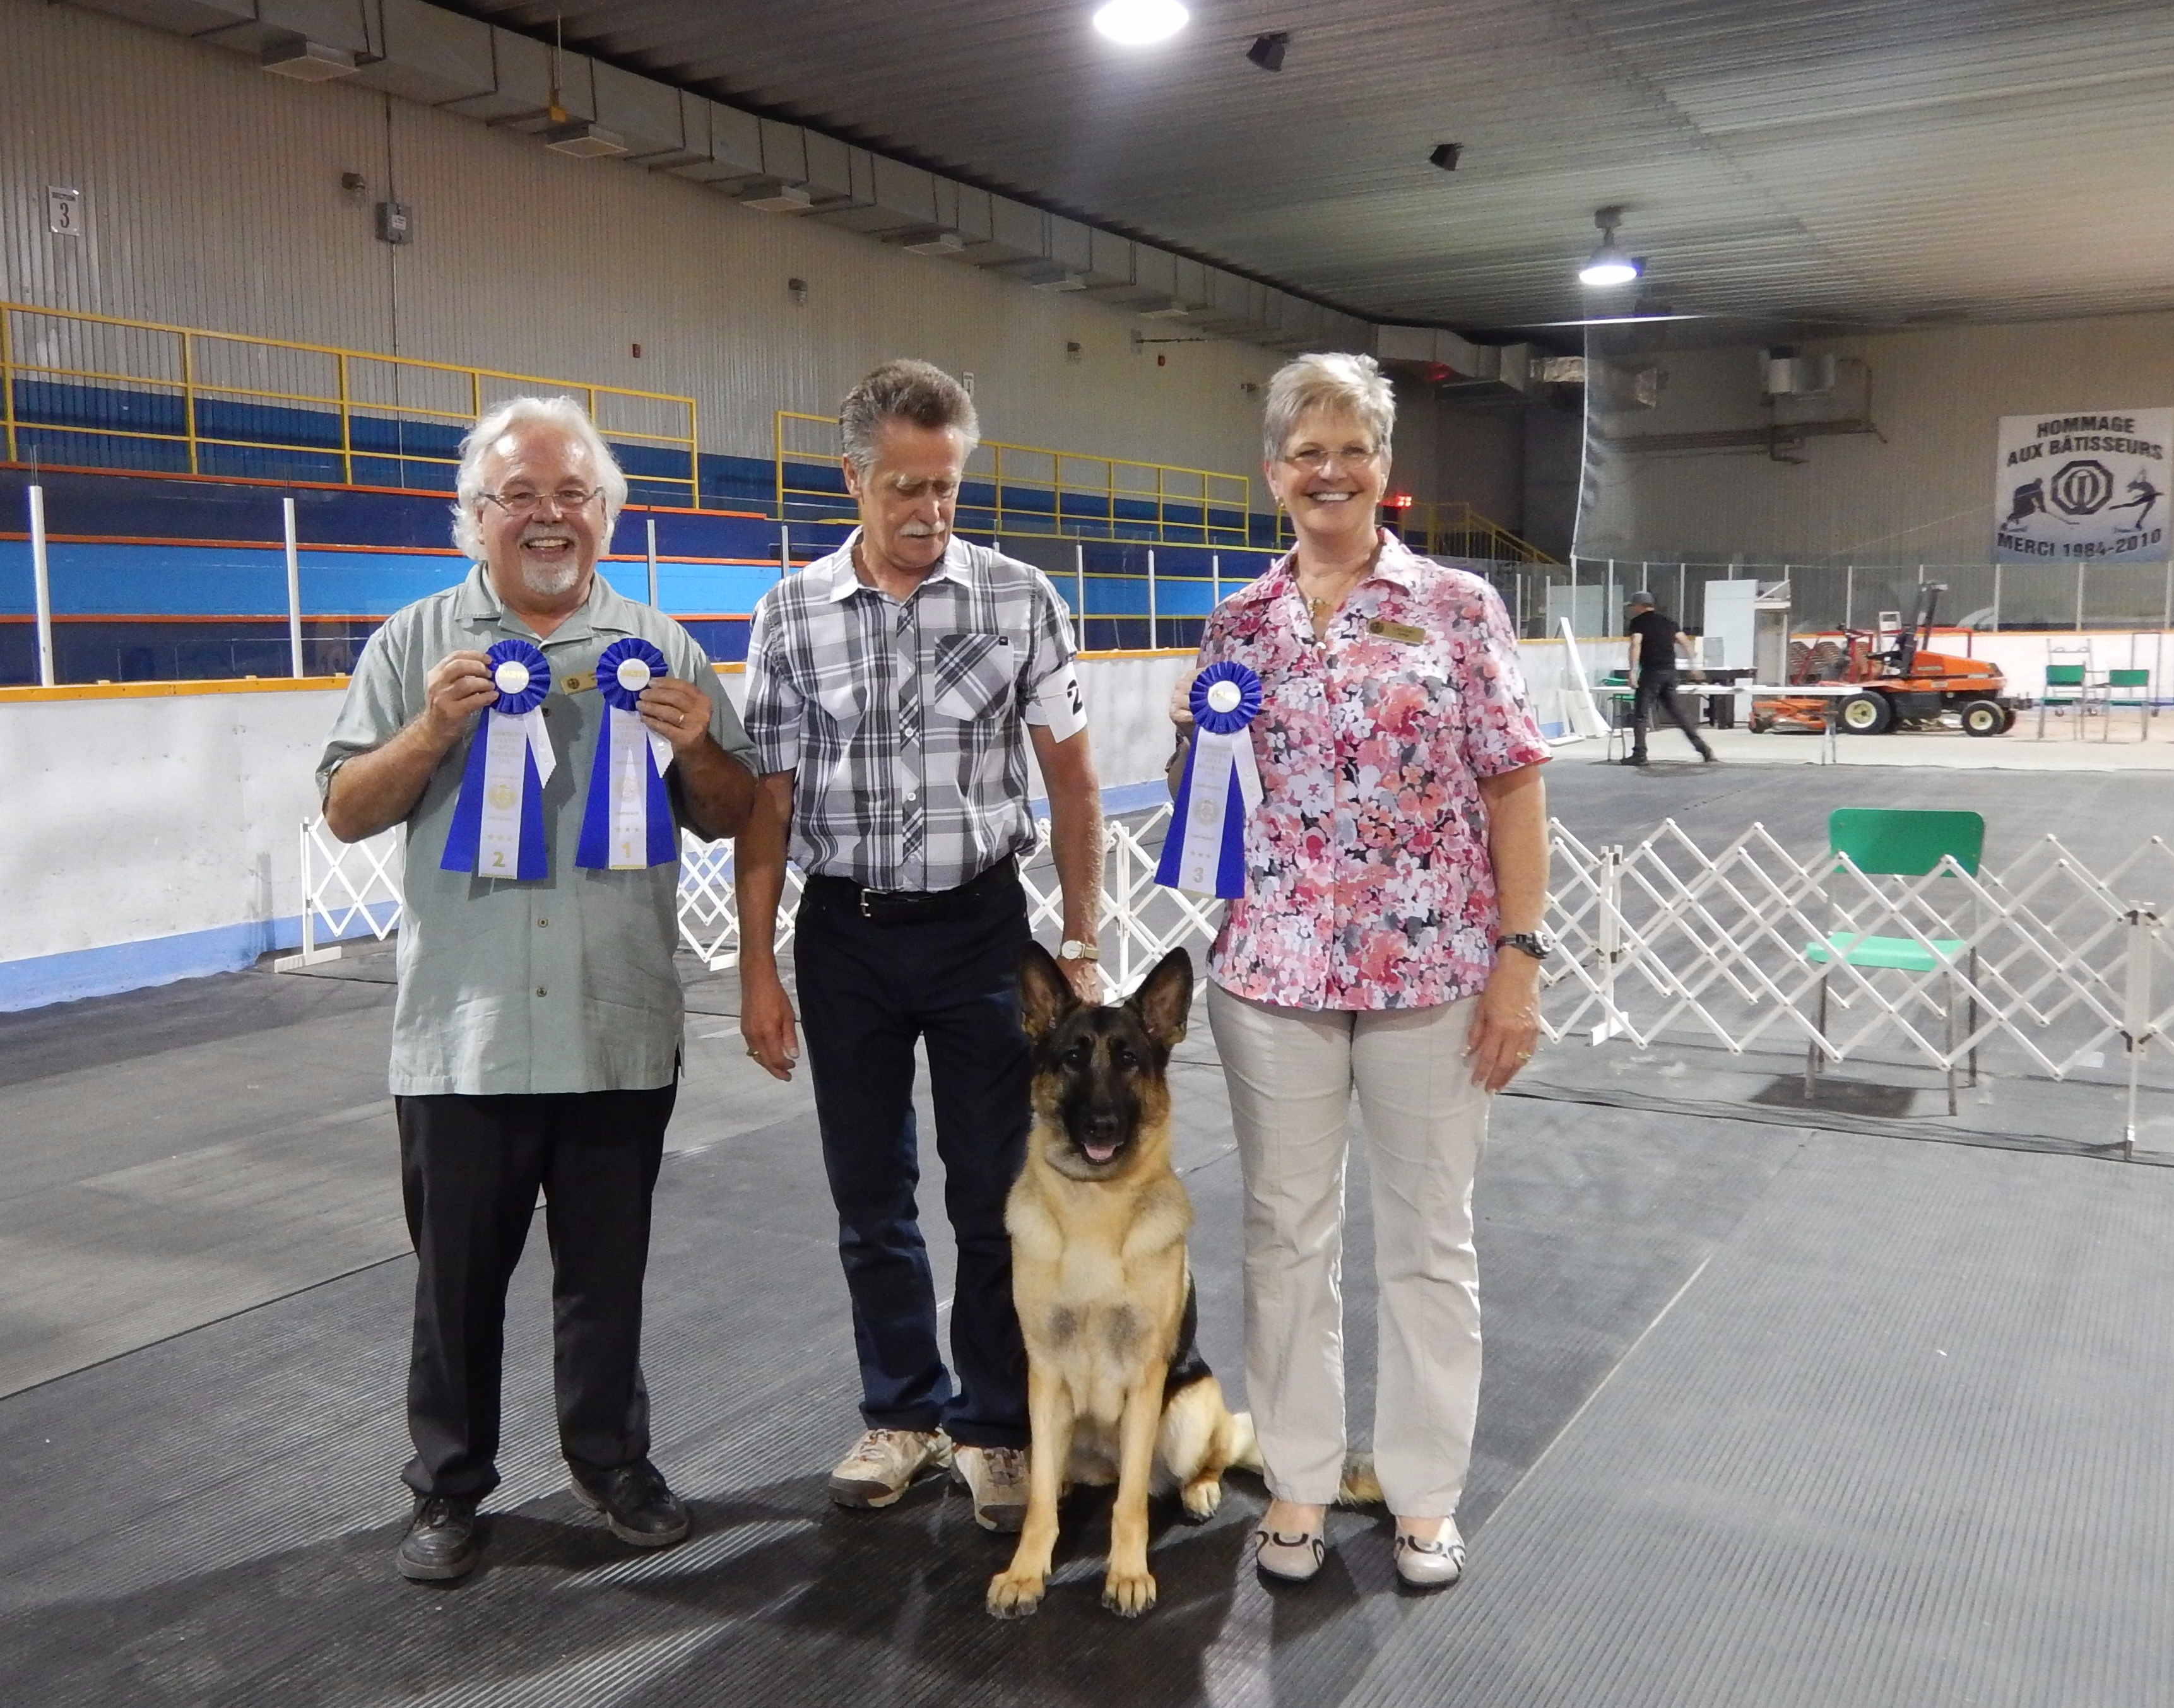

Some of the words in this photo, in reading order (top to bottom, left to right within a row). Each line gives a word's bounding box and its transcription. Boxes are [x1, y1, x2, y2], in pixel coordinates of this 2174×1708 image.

[60, 202, 70, 228] 3
[2036, 416, 2136, 438] HOMMAGE
[2007, 442, 2044, 467] AUX
[2049, 435, 2163, 460] BÂTISSEURS
[1997, 533, 2055, 557] MERCI
[2063, 528, 2161, 557] 1984-2010
[1066, 679, 1083, 716] 2
[492, 851, 505, 868] 2
[1193, 867, 1204, 883] 3
